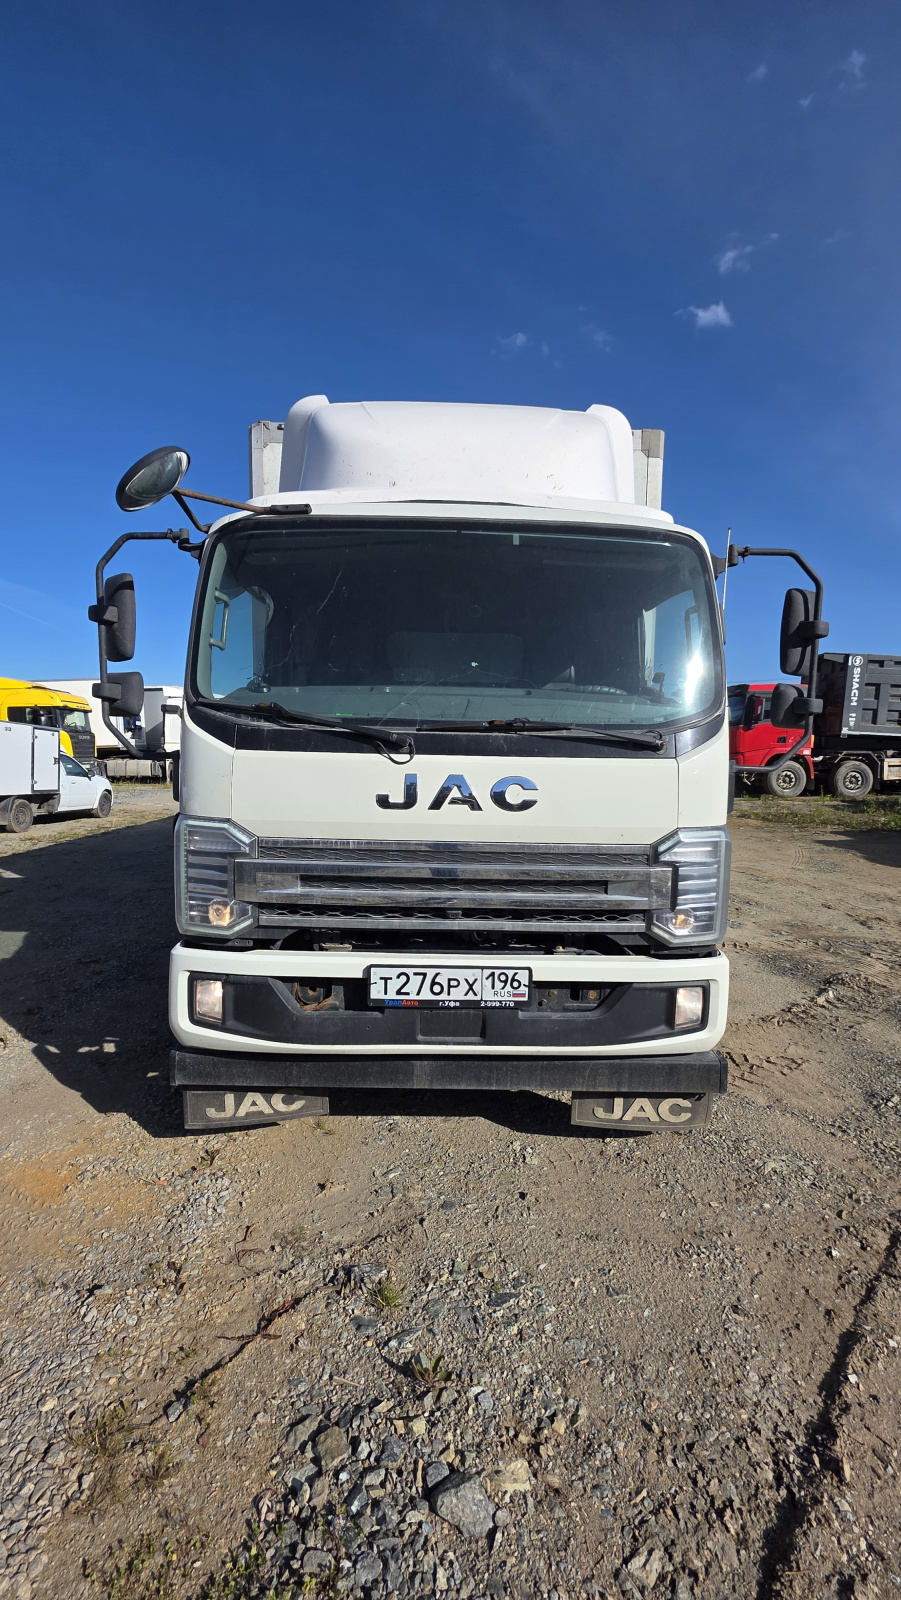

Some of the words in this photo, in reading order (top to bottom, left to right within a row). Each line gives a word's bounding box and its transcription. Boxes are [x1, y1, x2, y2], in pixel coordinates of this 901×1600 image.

[850, 667, 861, 706] SHACM
[375, 773, 539, 812] JAC
[379, 971, 479, 997] Т276РХ
[485, 971, 522, 990] 196
[493, 990, 512, 998] RUS
[205, 1088, 306, 1119] JAC
[593, 1097, 692, 1123] JAC
